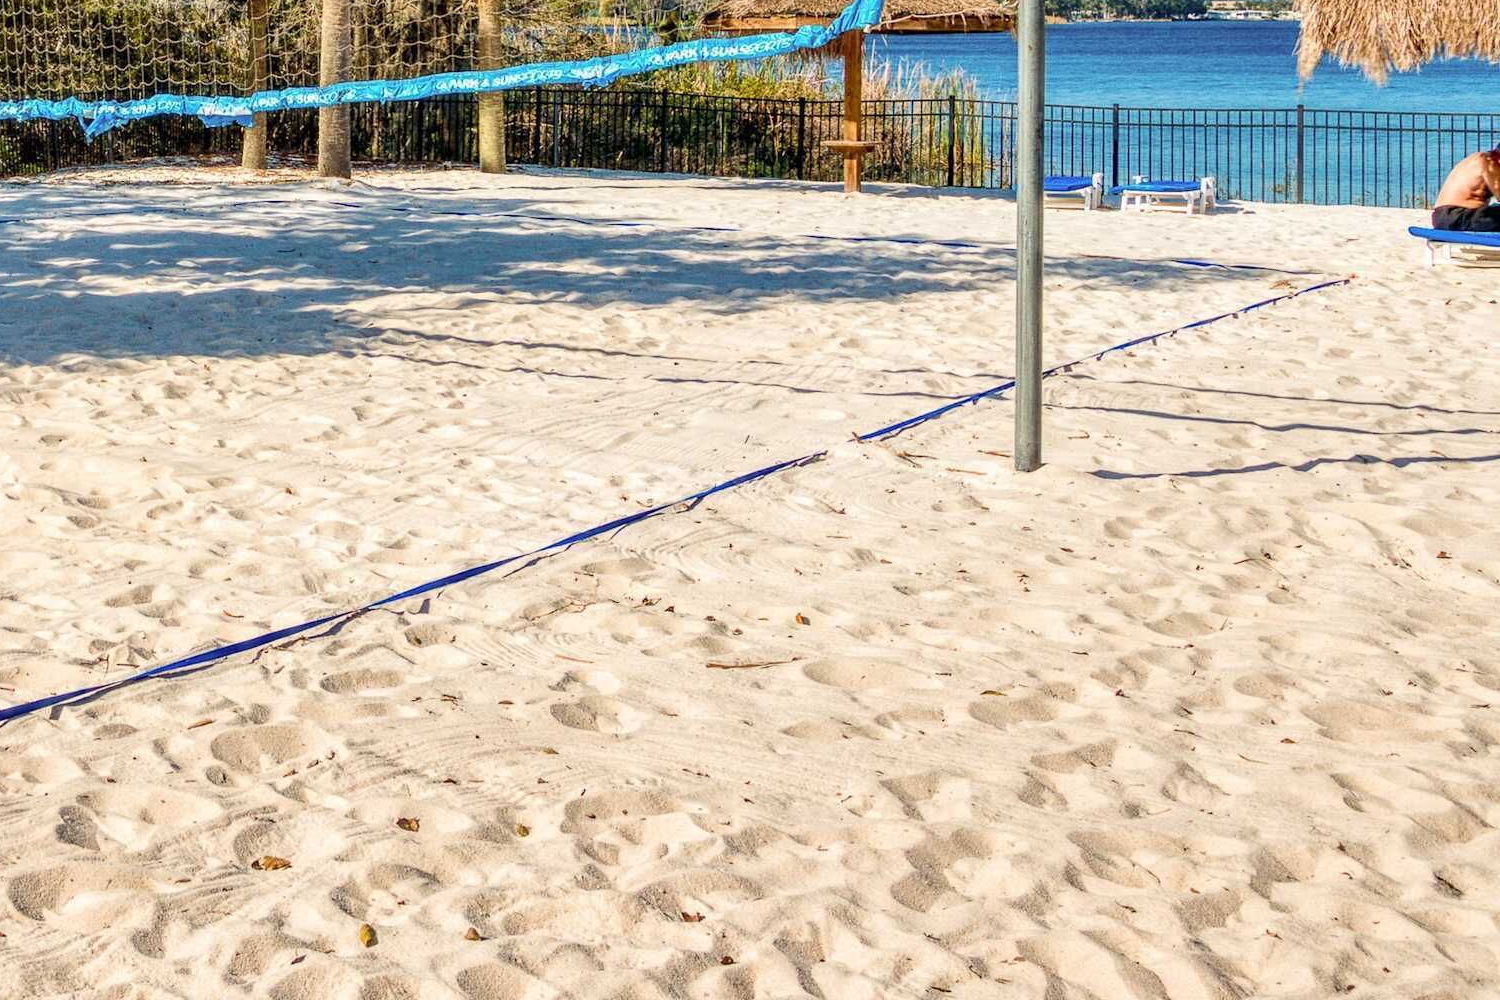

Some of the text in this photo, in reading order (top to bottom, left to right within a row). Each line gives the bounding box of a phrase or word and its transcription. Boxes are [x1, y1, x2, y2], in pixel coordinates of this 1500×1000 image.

[665, 47, 698, 62] PARK
[451, 77, 479, 90] PARK
[480, 78, 490, 88] &
